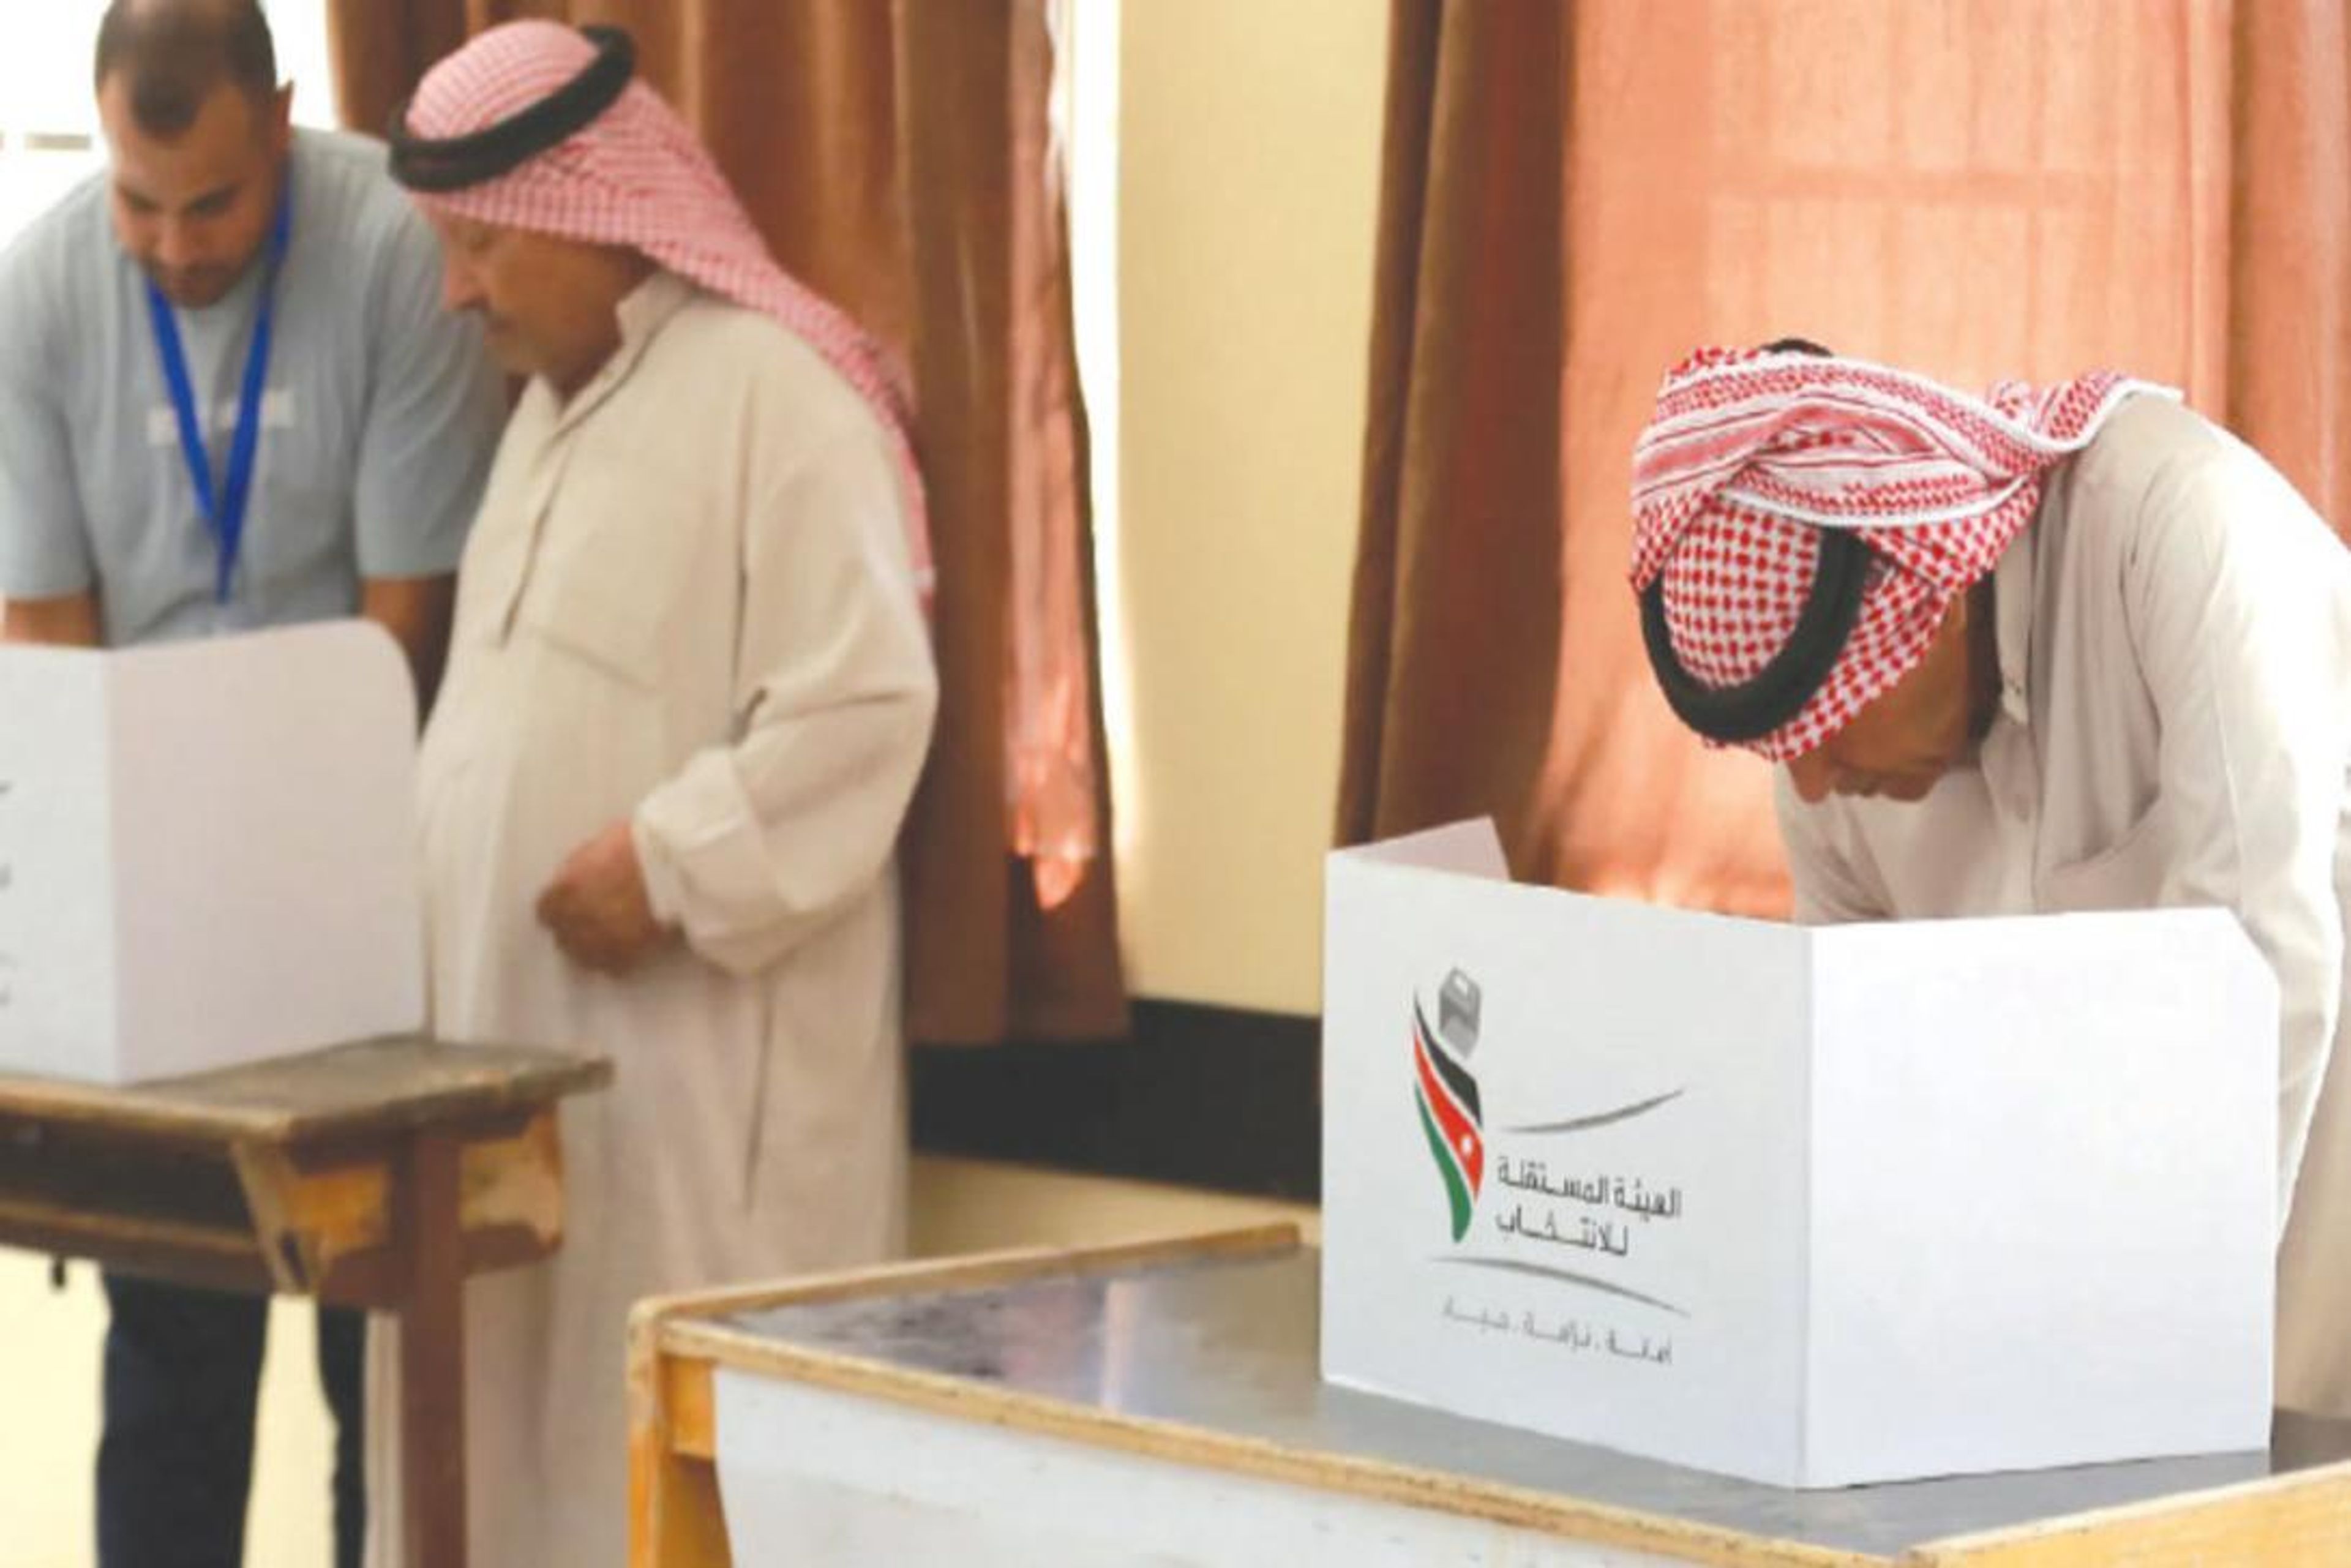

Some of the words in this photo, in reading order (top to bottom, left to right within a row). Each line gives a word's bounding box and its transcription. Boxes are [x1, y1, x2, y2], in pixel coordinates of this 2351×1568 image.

[1497, 1155, 1610, 1204] المستقلة
[1614, 1176, 1682, 1223] الهيئة
[1495, 1204, 1627, 1256] للانتخاب
